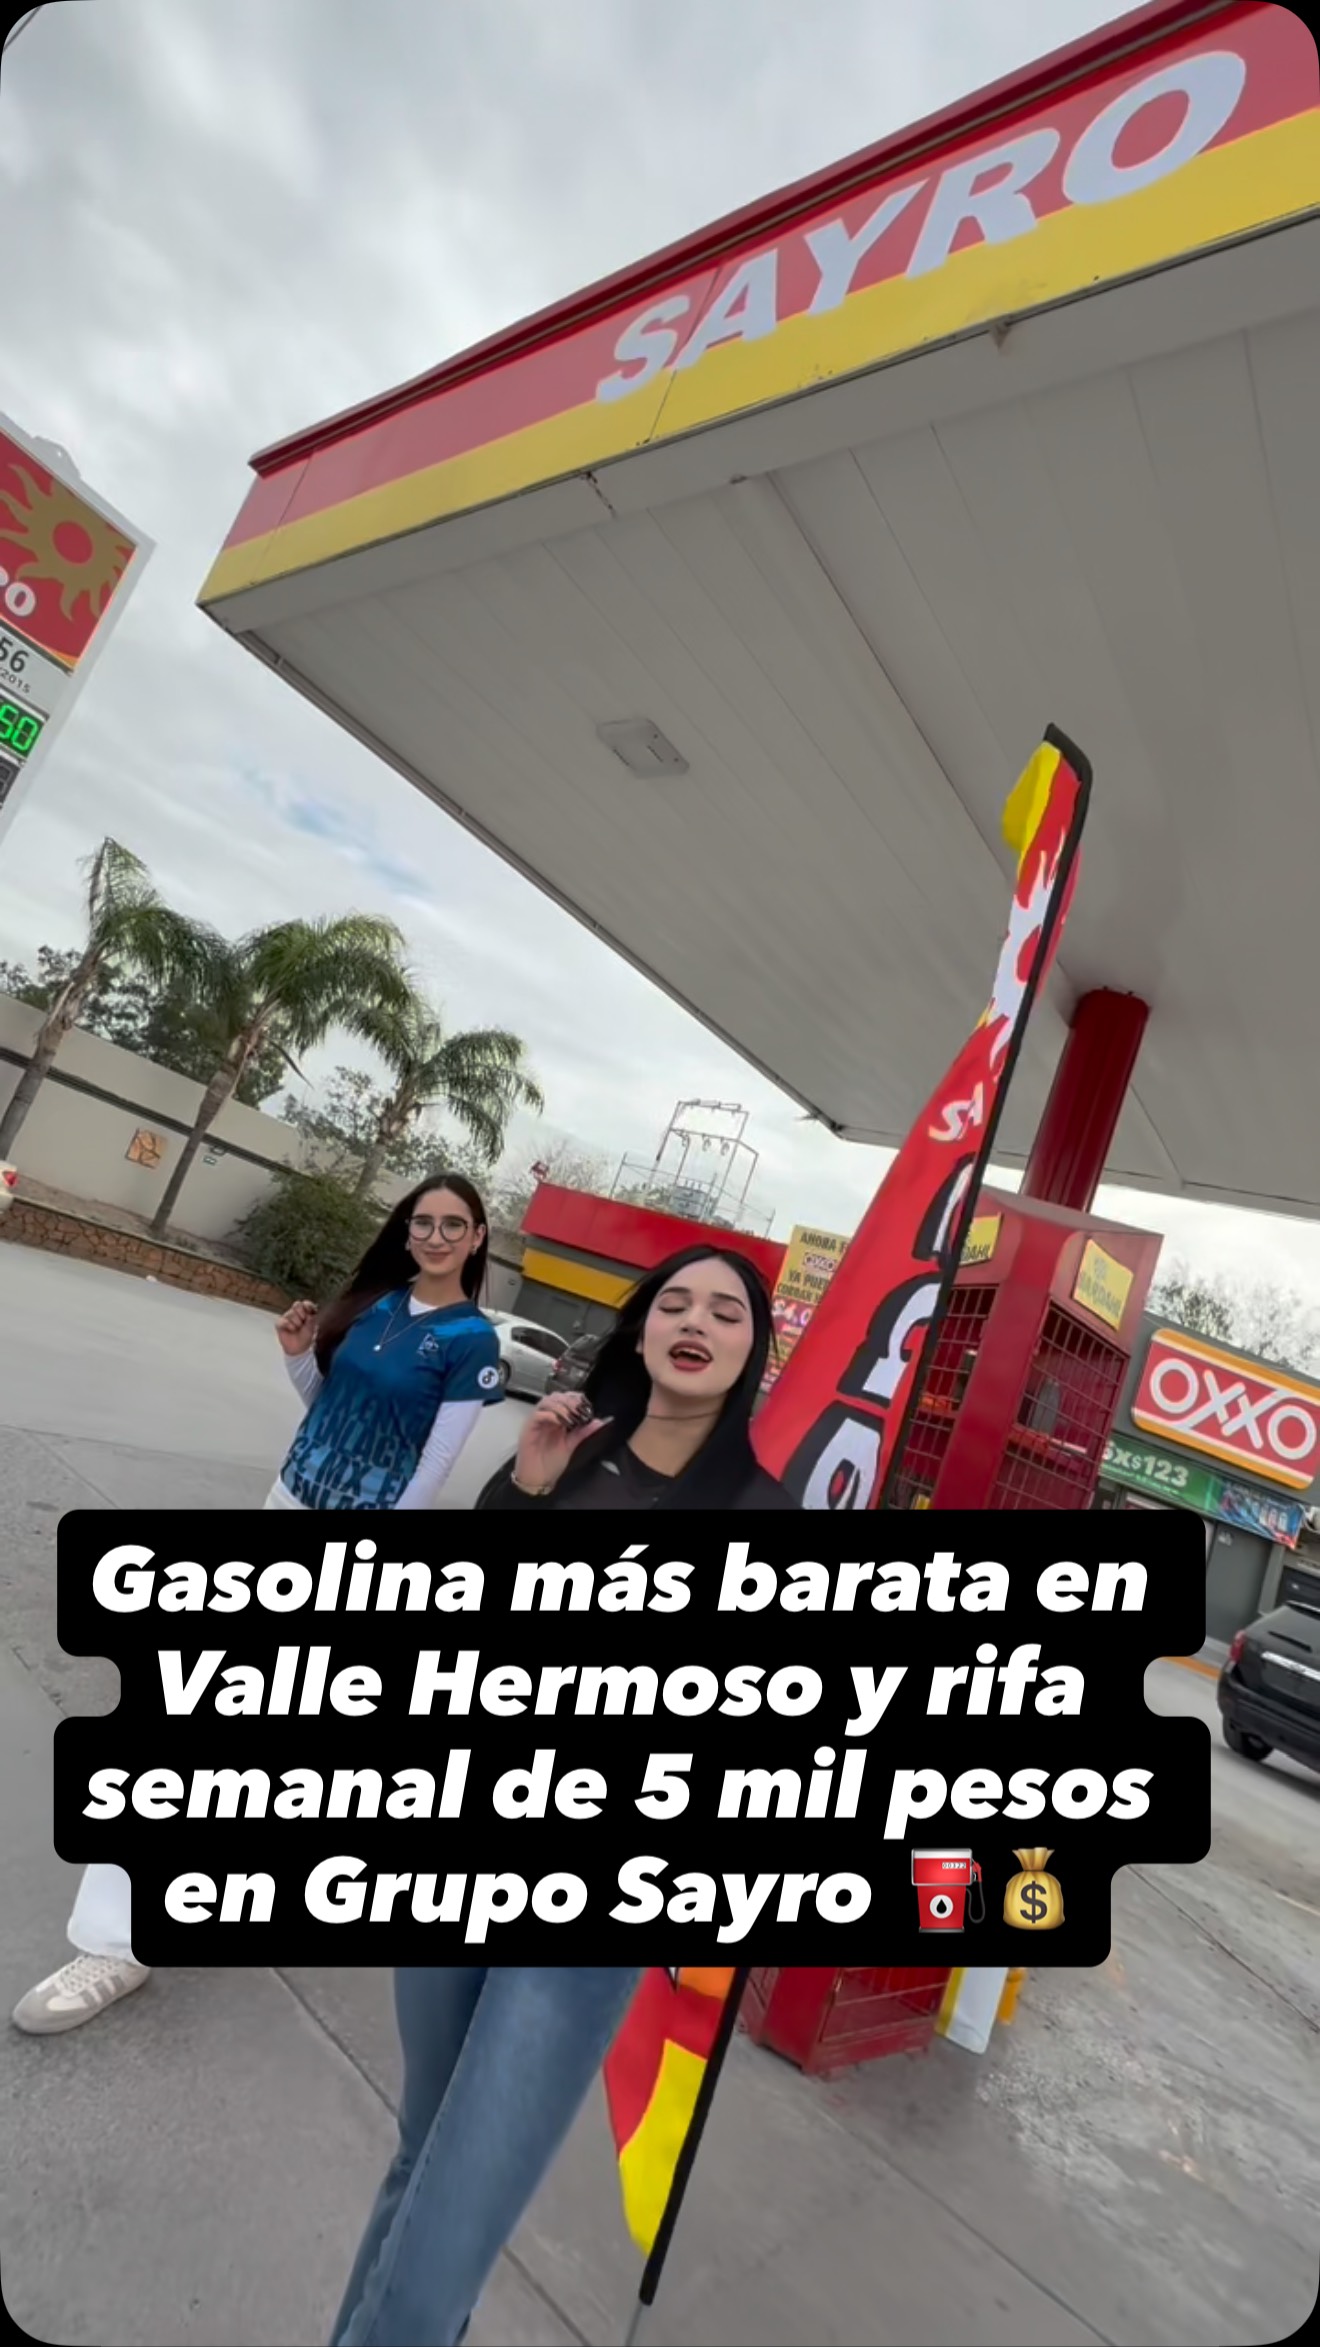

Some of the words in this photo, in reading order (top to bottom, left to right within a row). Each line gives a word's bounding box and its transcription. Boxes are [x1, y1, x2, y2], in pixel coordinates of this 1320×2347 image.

[595, 51, 1247, 403] SAYRO
[1150, 1358, 1317, 1461] OXXO
[316, 1450, 372, 1498] MX
